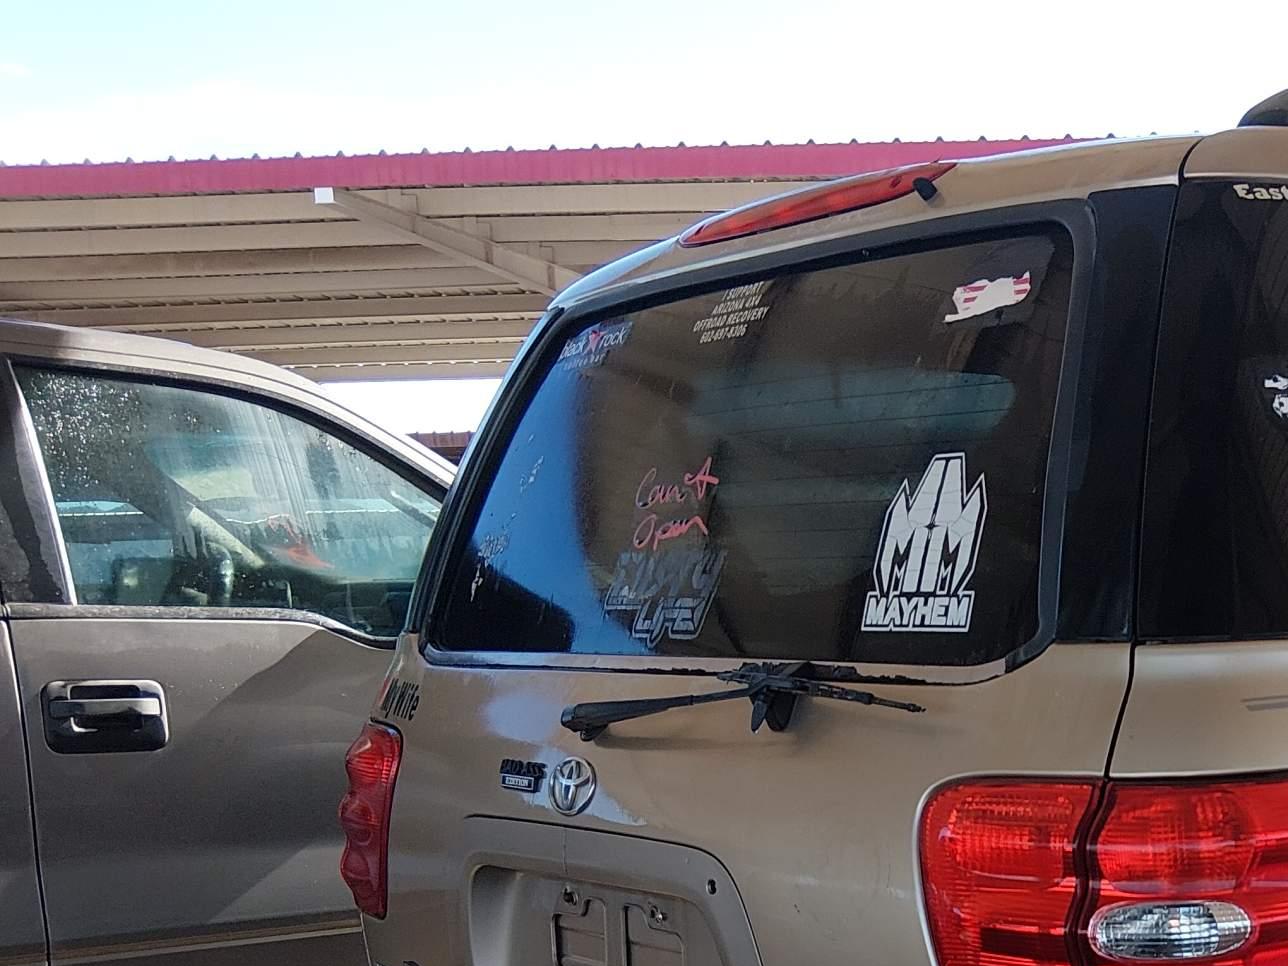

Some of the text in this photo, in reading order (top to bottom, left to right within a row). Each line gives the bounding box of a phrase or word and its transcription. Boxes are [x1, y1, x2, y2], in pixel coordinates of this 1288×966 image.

[727, 281, 764, 300] SUPPORT
[693, 306, 770, 333] OFFROAD RECOVERY
[711, 298, 746, 316] ARIZONA
[599, 327, 626, 350] rock
[865, 597, 970, 627] MAYHEM
[394, 681, 419, 721] Wife
